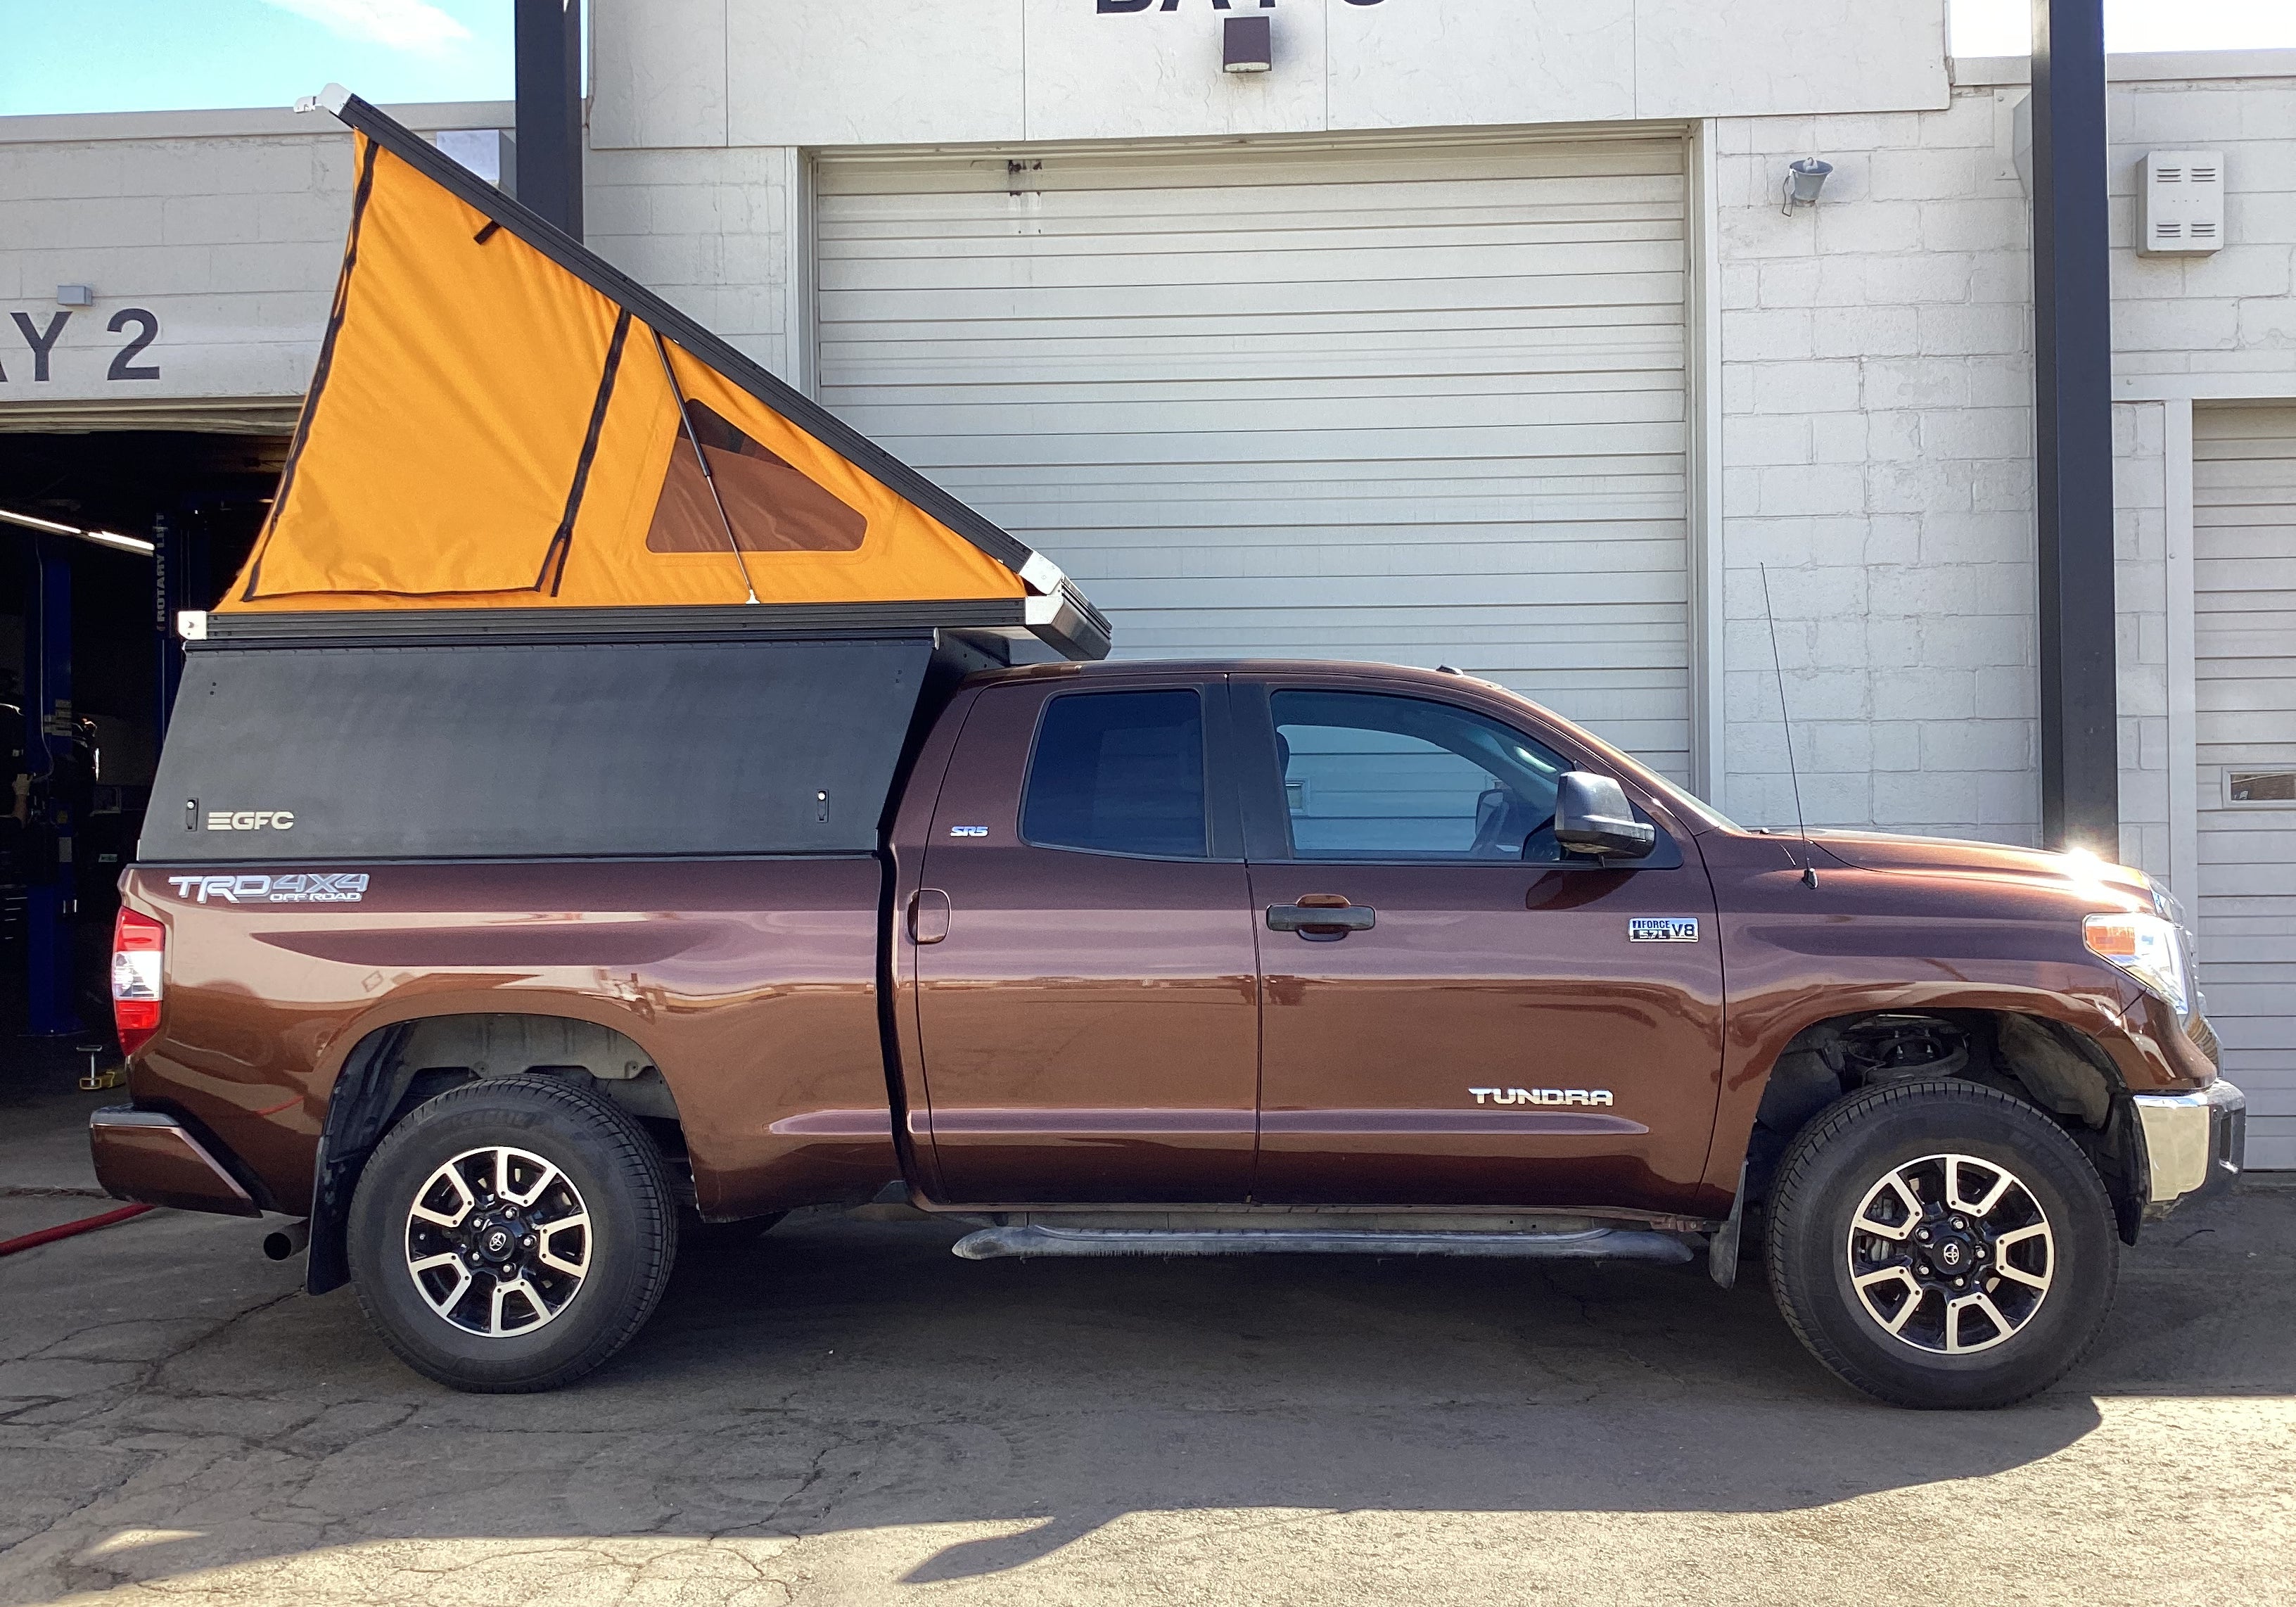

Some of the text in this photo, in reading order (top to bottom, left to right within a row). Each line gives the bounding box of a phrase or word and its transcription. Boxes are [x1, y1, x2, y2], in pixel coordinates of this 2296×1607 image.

[106, 307, 160, 381] 2
[155, 512, 166, 622] ROTARY LIFT
[950, 825, 988, 837] SR5
[168, 875, 272, 903] TRD
[269, 892, 362, 902] OFF ROAD
[1671, 923, 1695, 937] V8
[1468, 1088, 1614, 1107] TUNDRA
